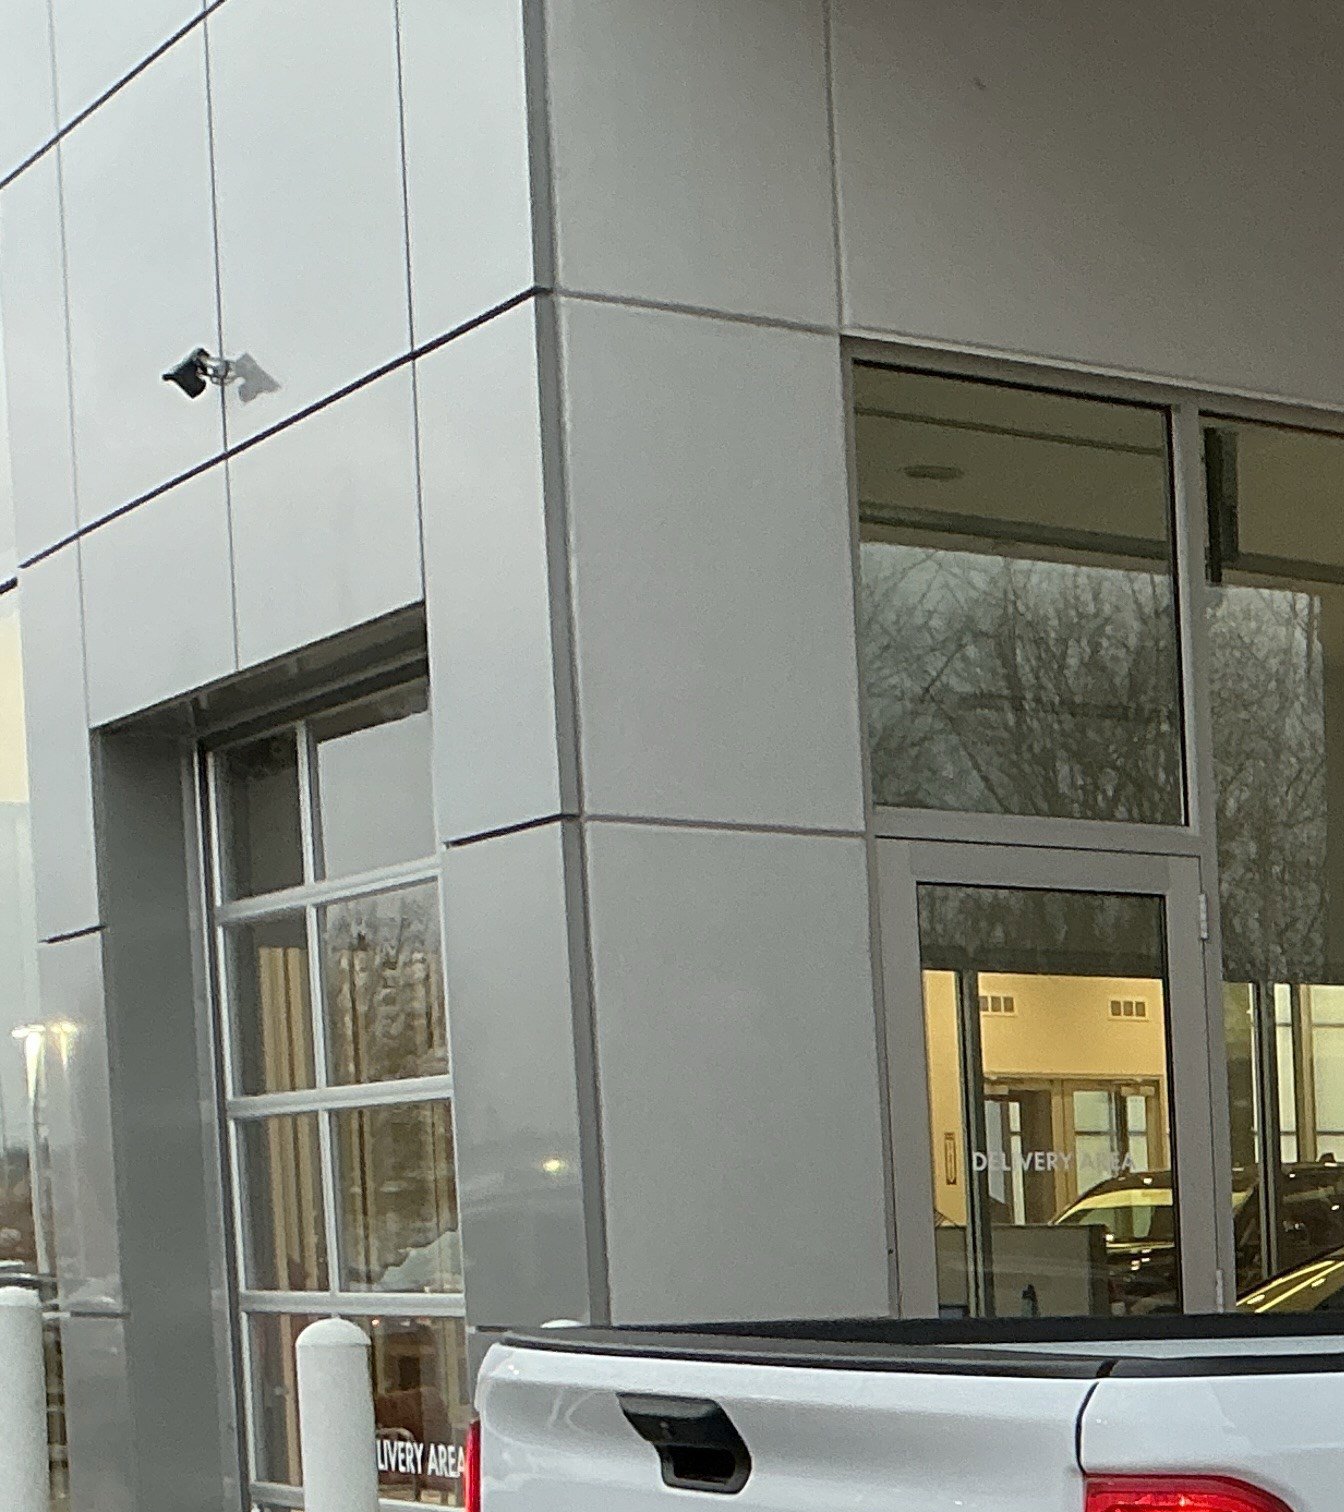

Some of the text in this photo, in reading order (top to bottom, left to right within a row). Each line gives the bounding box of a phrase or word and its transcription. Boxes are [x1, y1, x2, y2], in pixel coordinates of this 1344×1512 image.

[971, 1151, 1073, 1172] DELVERY
[376, 1440, 465, 1478] LIVERY AREA
